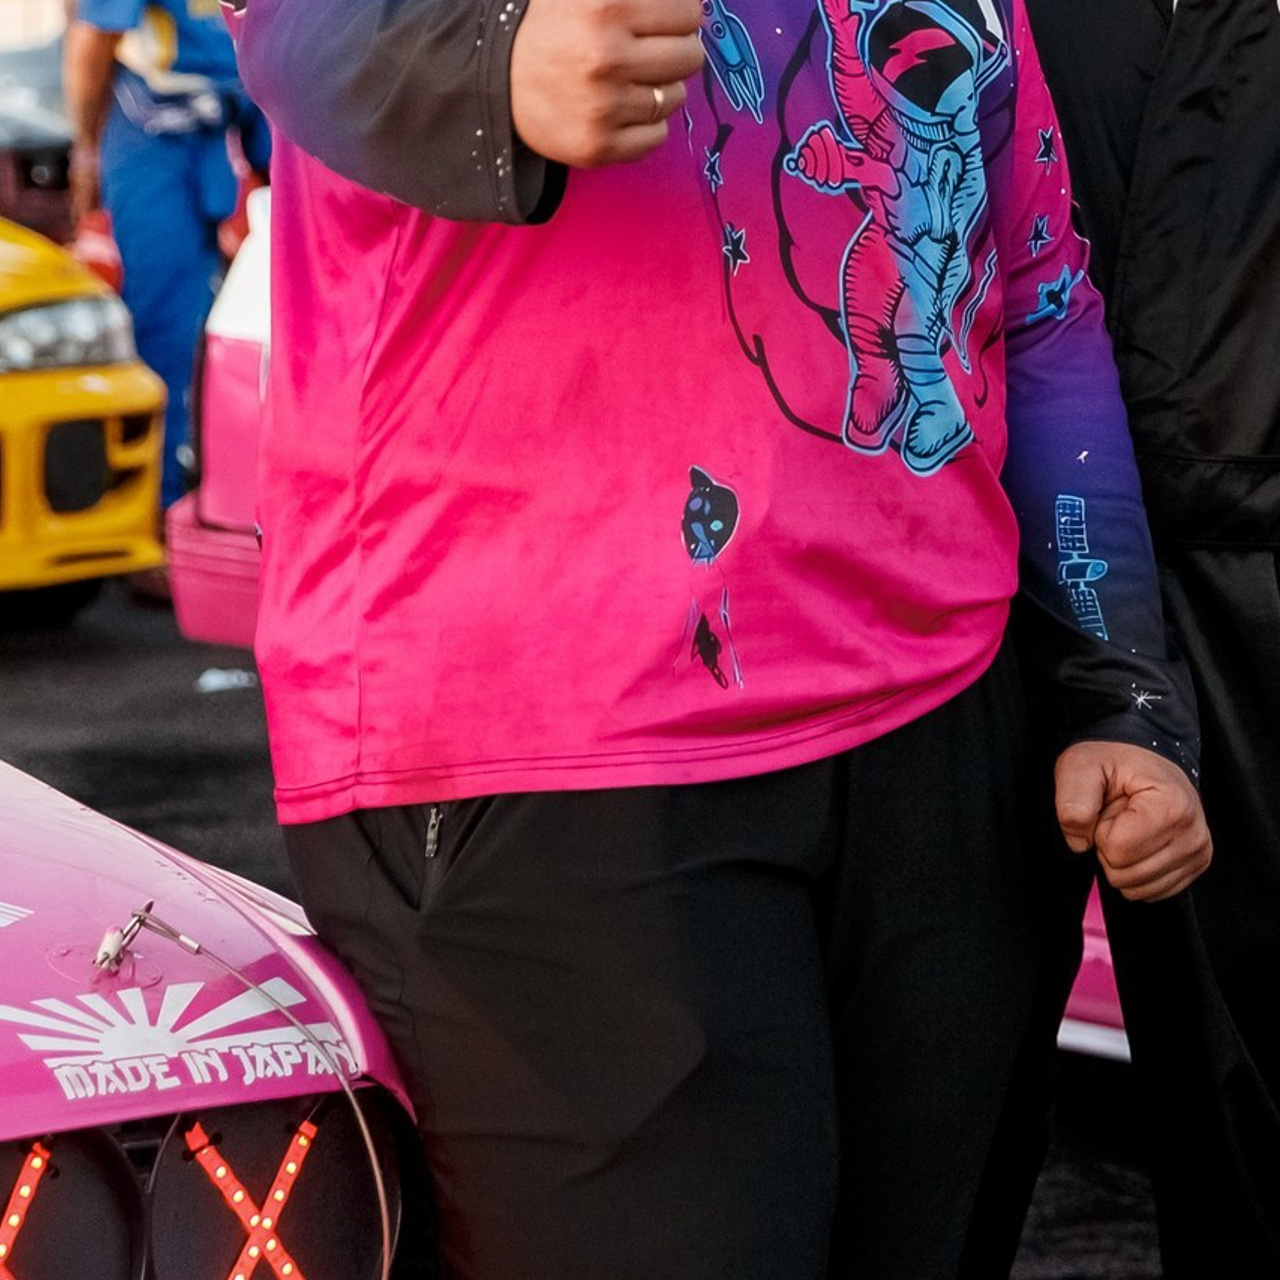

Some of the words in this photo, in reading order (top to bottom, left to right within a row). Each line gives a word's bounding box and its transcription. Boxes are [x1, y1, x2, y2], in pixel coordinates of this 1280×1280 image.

[53, 1054, 181, 1100] MADE
[181, 1048, 228, 1085] IN
[231, 1040, 363, 1086] JAPAN
